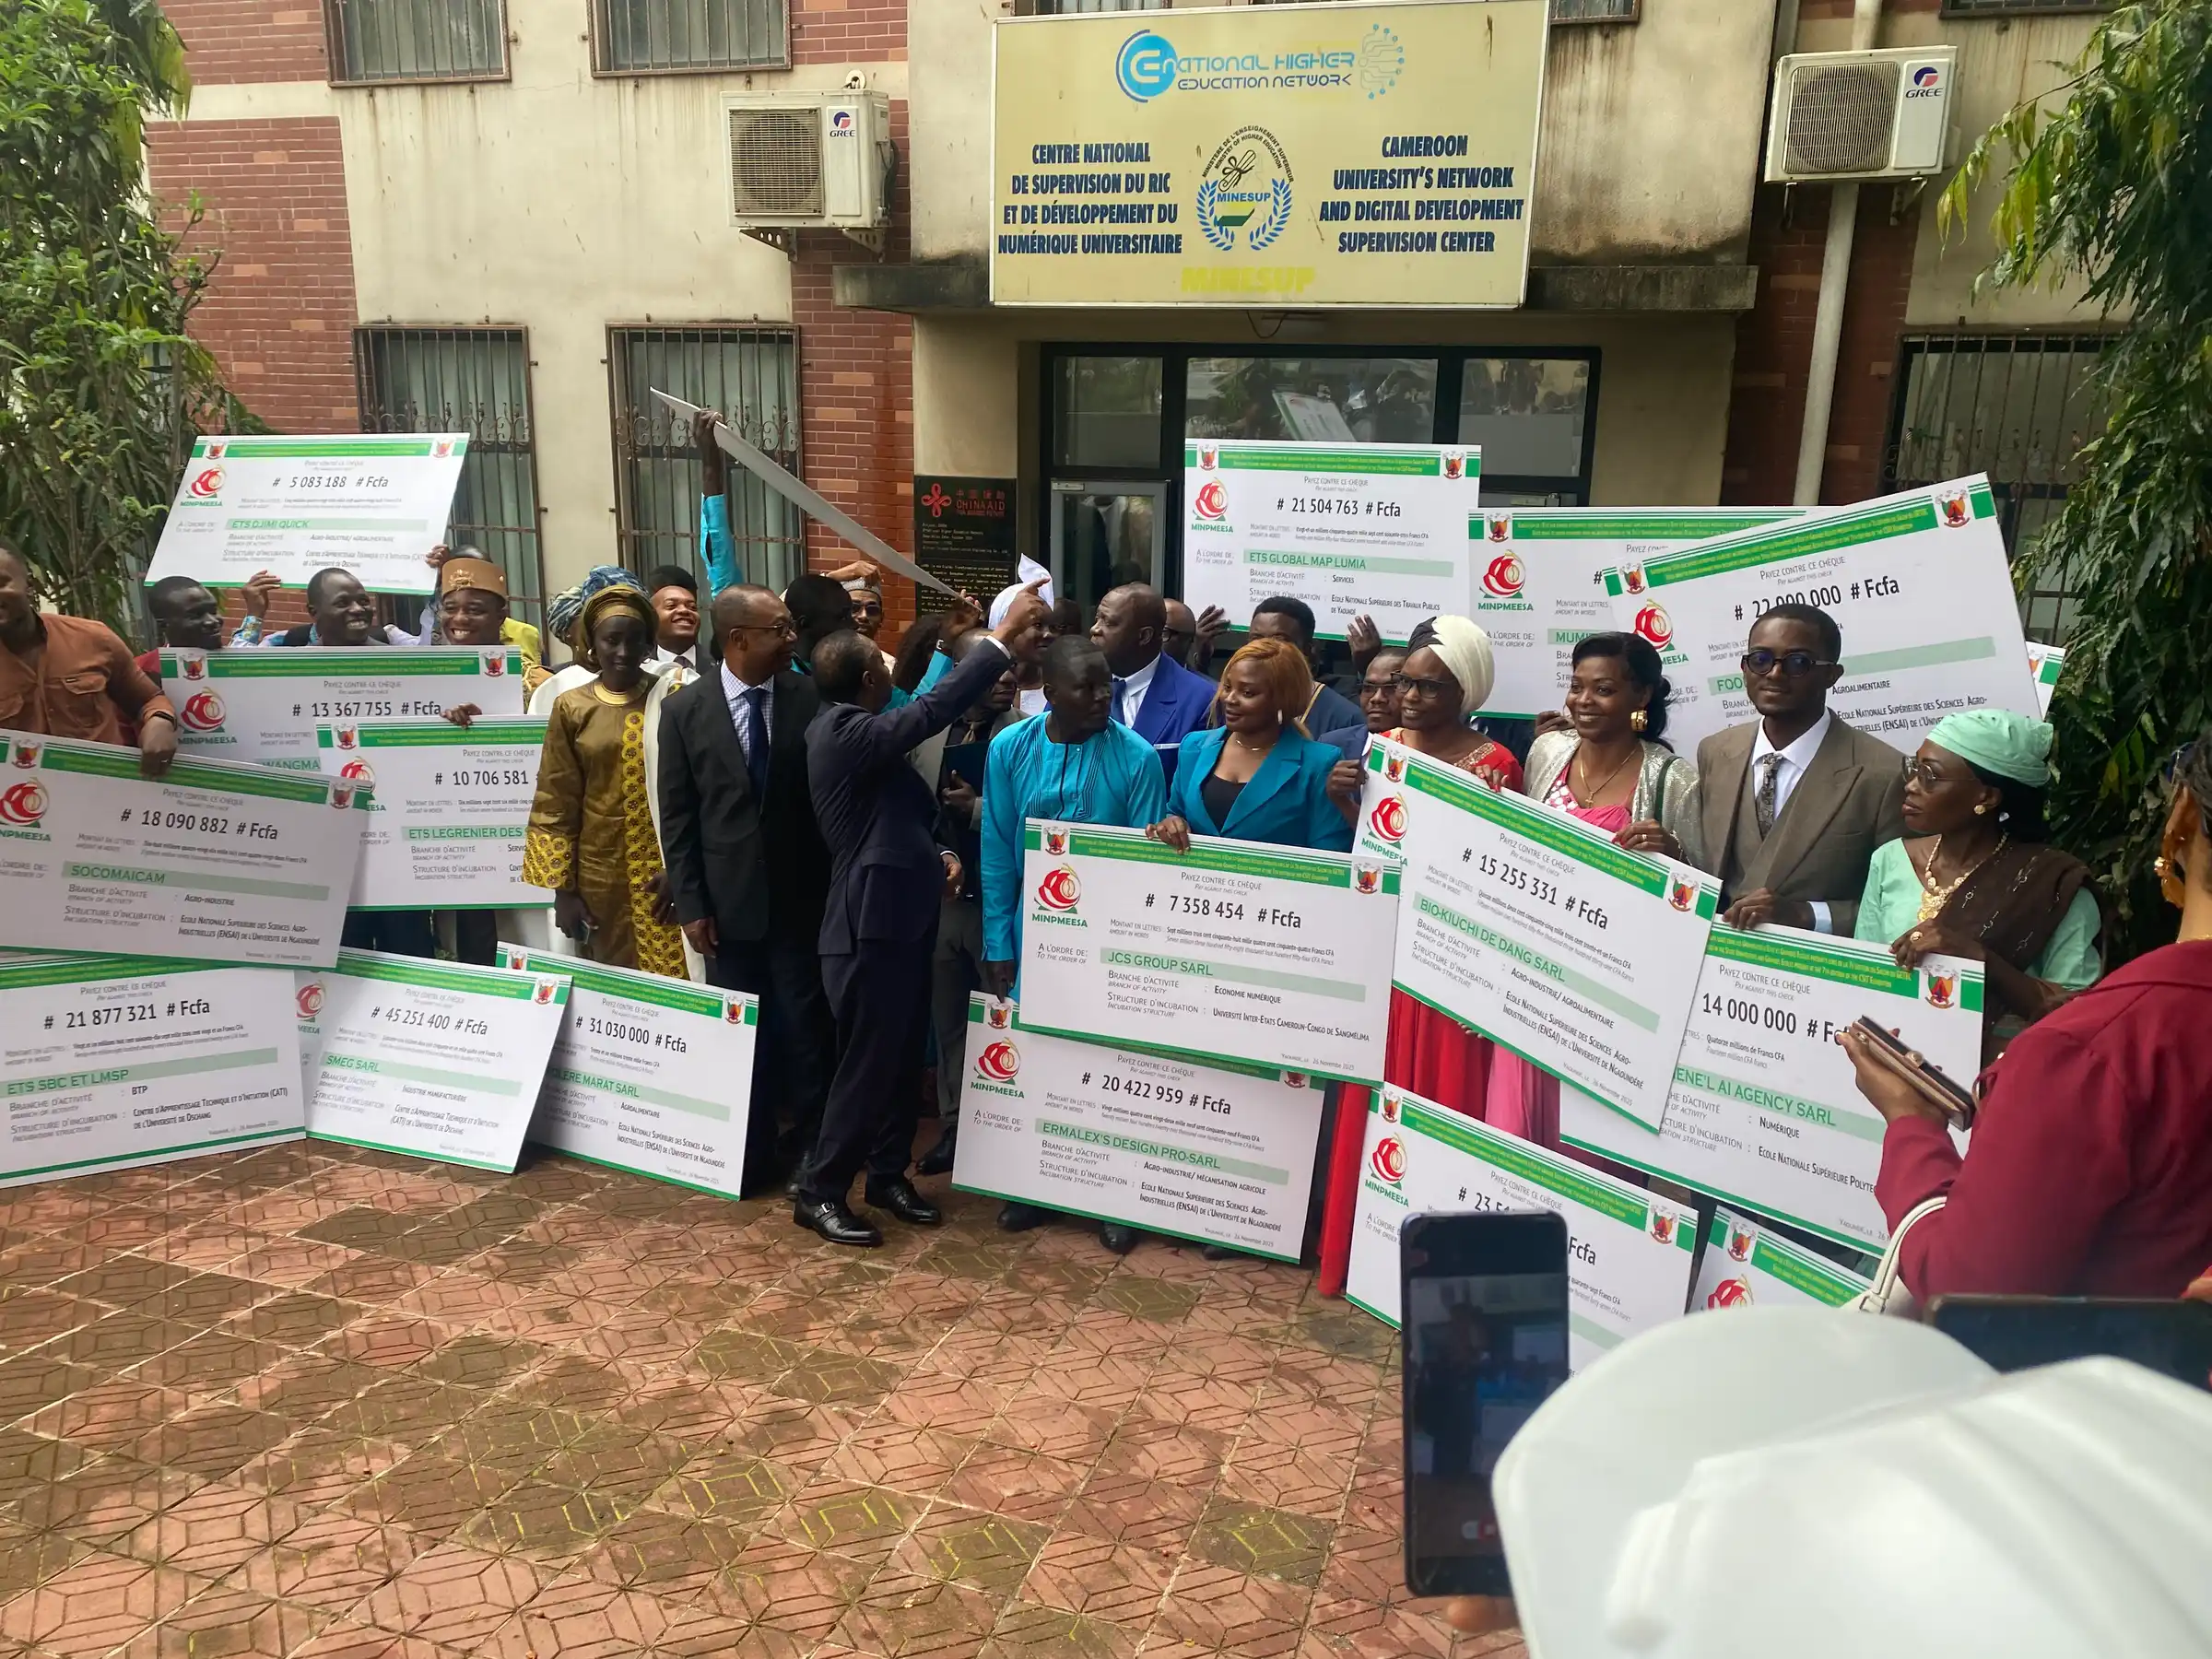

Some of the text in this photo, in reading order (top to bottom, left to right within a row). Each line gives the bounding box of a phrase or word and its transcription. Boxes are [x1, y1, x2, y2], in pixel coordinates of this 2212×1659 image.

[1275, 53, 1354, 70] HIGHER
[1178, 74, 1352, 90] EDUCATION NETWORK
[1906, 88, 1943, 98] GREE
[1032, 143, 1150, 164] CENTRE NATIONAL
[1215, 146, 1233, 169] MINISTRY
[1263, 140, 1282, 169] EDUCATION
[1382, 135, 1468, 158] CAMEROON
[1202, 147, 1224, 178] MINISTERE
[1223, 138, 1230, 147] DE
[1012, 172, 1171, 194] DE SUPERVISION DU RIC
[1334, 166, 1514, 190] UNIVERSITY'S NETWORK
[1217, 193, 1271, 202] MINESUP
[1004, 200, 1178, 224] ET DE DÉVELOPPEMENT DU
[1320, 200, 1524, 221] AND DIGITAL DEVELOPMENT
[998, 230, 1182, 254] NUMÉRIQUE UNIVERSITAIRE
[1338, 231, 1495, 253] SUPERVISION CENTER
[1182, 267, 1314, 293] MINESUP
[289, 477, 389, 488] 5 083 188 Fcfa
[1292, 497, 1401, 517] 21 504 763 Fcfa
[232, 520, 253, 529] ETS
[279, 520, 311, 529] QUICK
[1191, 524, 1233, 534] MINPMEESA
[1250, 552, 1366, 570] ETS GLOBAL MAP LUMIA
[1865, 576, 1900, 598] Fcfa
[1478, 602, 1534, 611] MINPMEESA
[312, 700, 441, 717] 13 367 755 Fcfa
[453, 771, 529, 785] 10 706 581
[141, 809, 278, 841] 18 090 882 Fcfa
[409, 828, 523, 839] ETS LEGRENIER DES
[1479, 854, 1608, 930] 15 255 331 Fcfa
[1032, 913, 1088, 928] MINPMEESA
[1171, 896, 1301, 929] 7 358 454 Fcfa
[1420, 898, 1566, 982] BIO-KIUCHI DE DANG SARL
[1109, 951, 1213, 977] JCS GROUP SARL
[66, 999, 210, 1029] 21 877 321 Fcfa
[385, 1008, 488, 1035] 45 251 400 Fcfa
[1702, 993, 1796, 1034] 14 000 000
[590, 1018, 687, 1053] 31 030 000 Fcfa
[326, 1055, 380, 1073] SMEG SARL
[7, 1069, 129, 1095] ETS SBC ET LMSP
[132, 1085, 147, 1096] BTP
[582, 1077, 614, 1091] MARAT
[616, 1083, 640, 1097] SARL
[971, 1081, 1024, 1099] MINPMEESA
[1101, 1075, 1231, 1114] 20 422 959 Fcfa
[1718, 1080, 1731, 1096] AI
[1735, 1086, 1794, 1112] AGENCY
[1797, 1102, 1837, 1126] SARL
[1043, 1123, 1220, 1170] ERMALEX'S DESIGN PRO-SARL
[1365, 1179, 1409, 1207] MINPMEESA
[1476, 1193, 1596, 1265] 23 Fcfa
